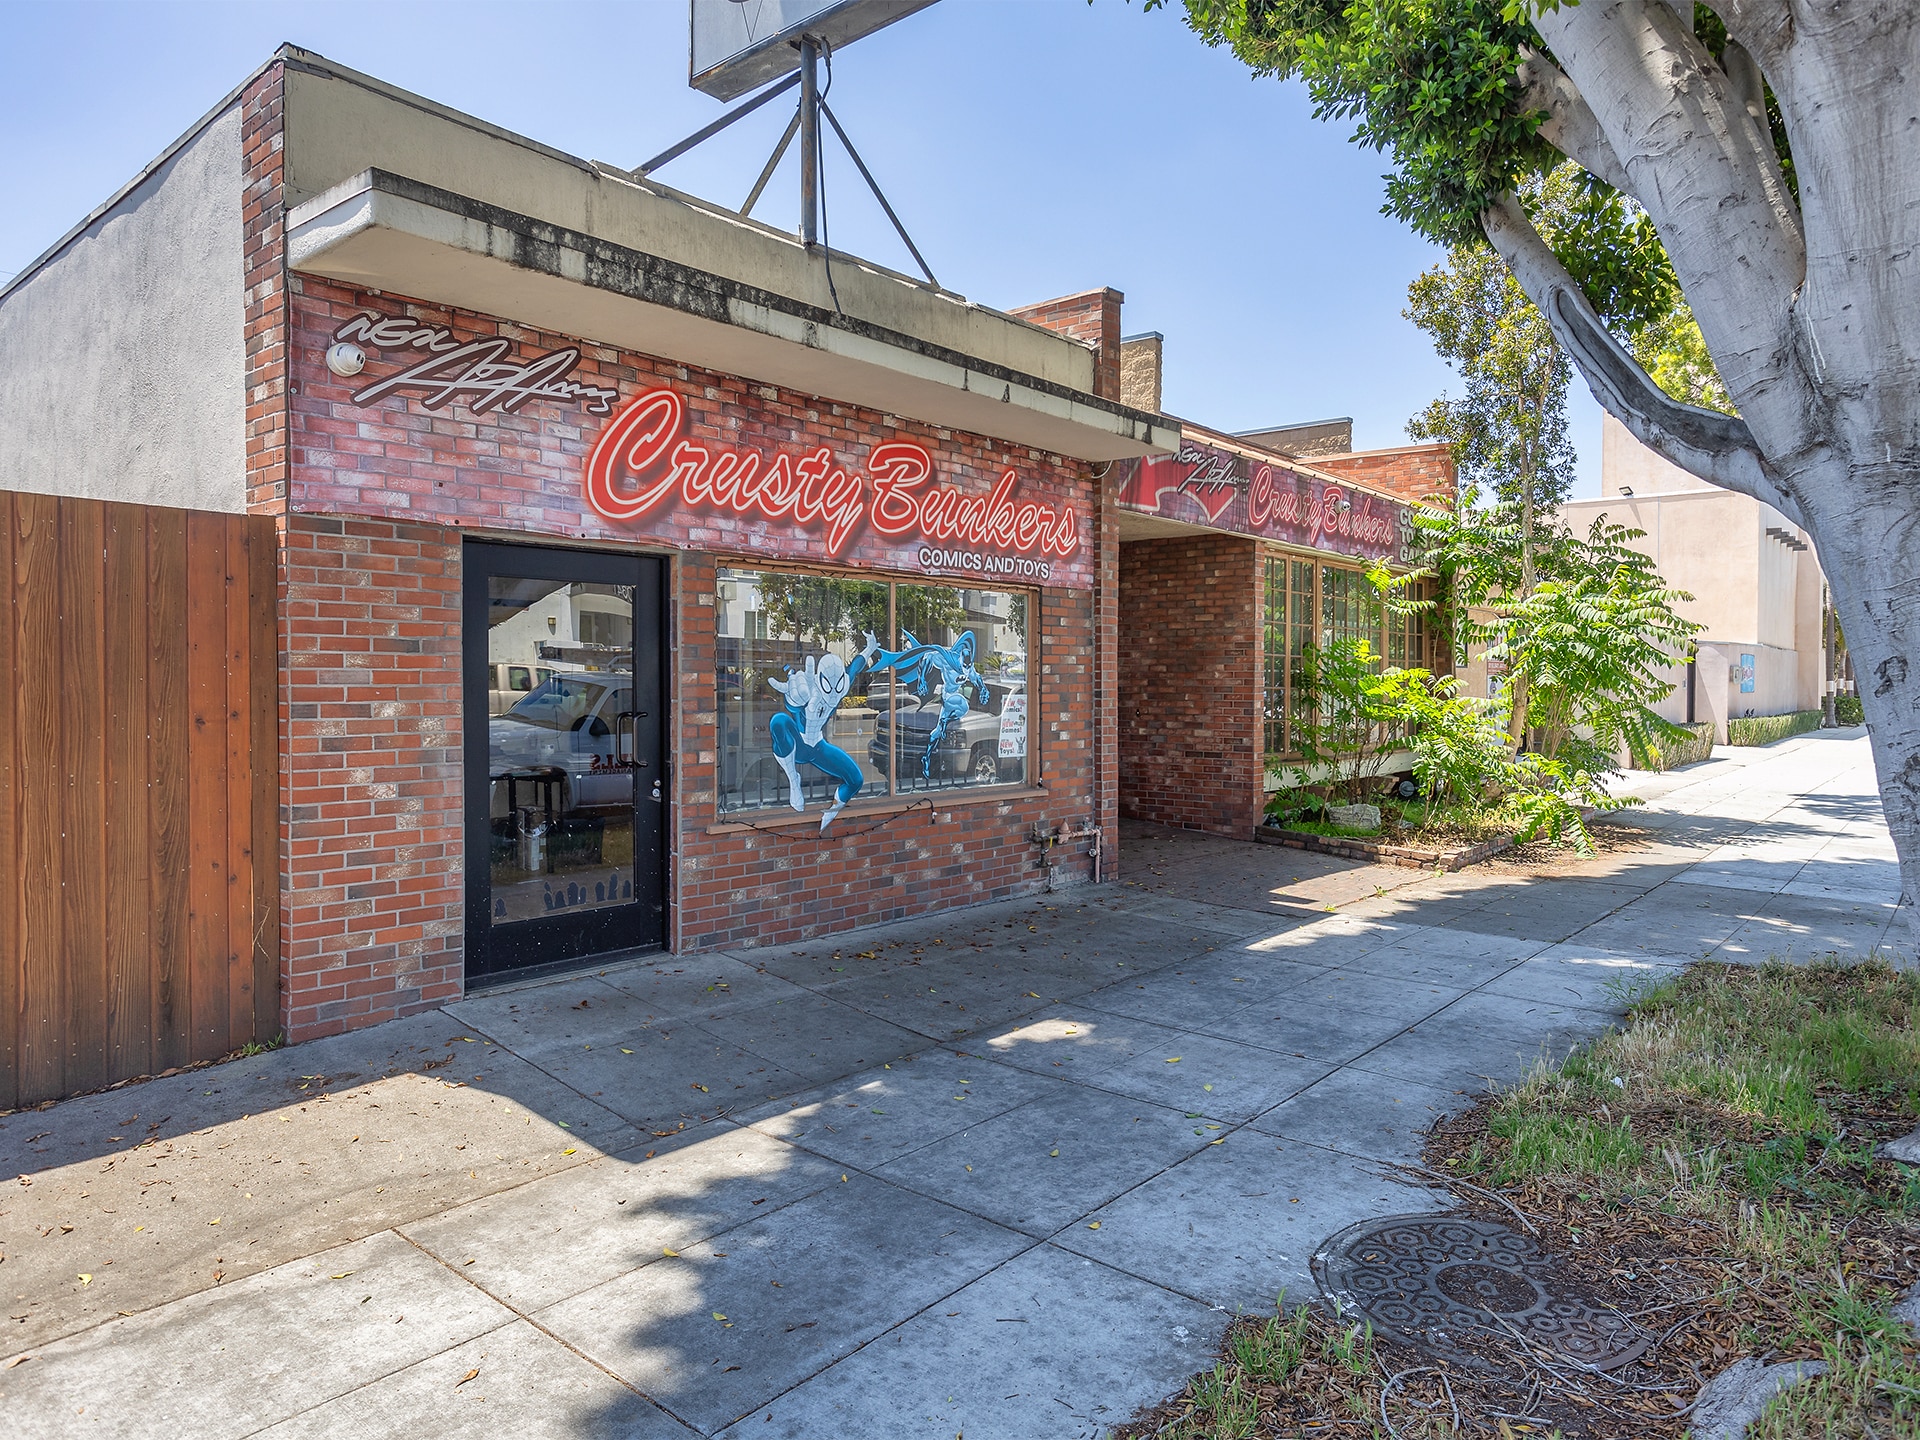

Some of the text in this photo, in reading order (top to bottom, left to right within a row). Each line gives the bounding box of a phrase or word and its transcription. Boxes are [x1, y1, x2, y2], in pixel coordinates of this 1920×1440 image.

[586, 389, 1078, 556] Crusty Bunkers
[1249, 465, 1394, 546] Crusty Bunkers
[919, 548, 1050, 579] COMICS AND TOYS
